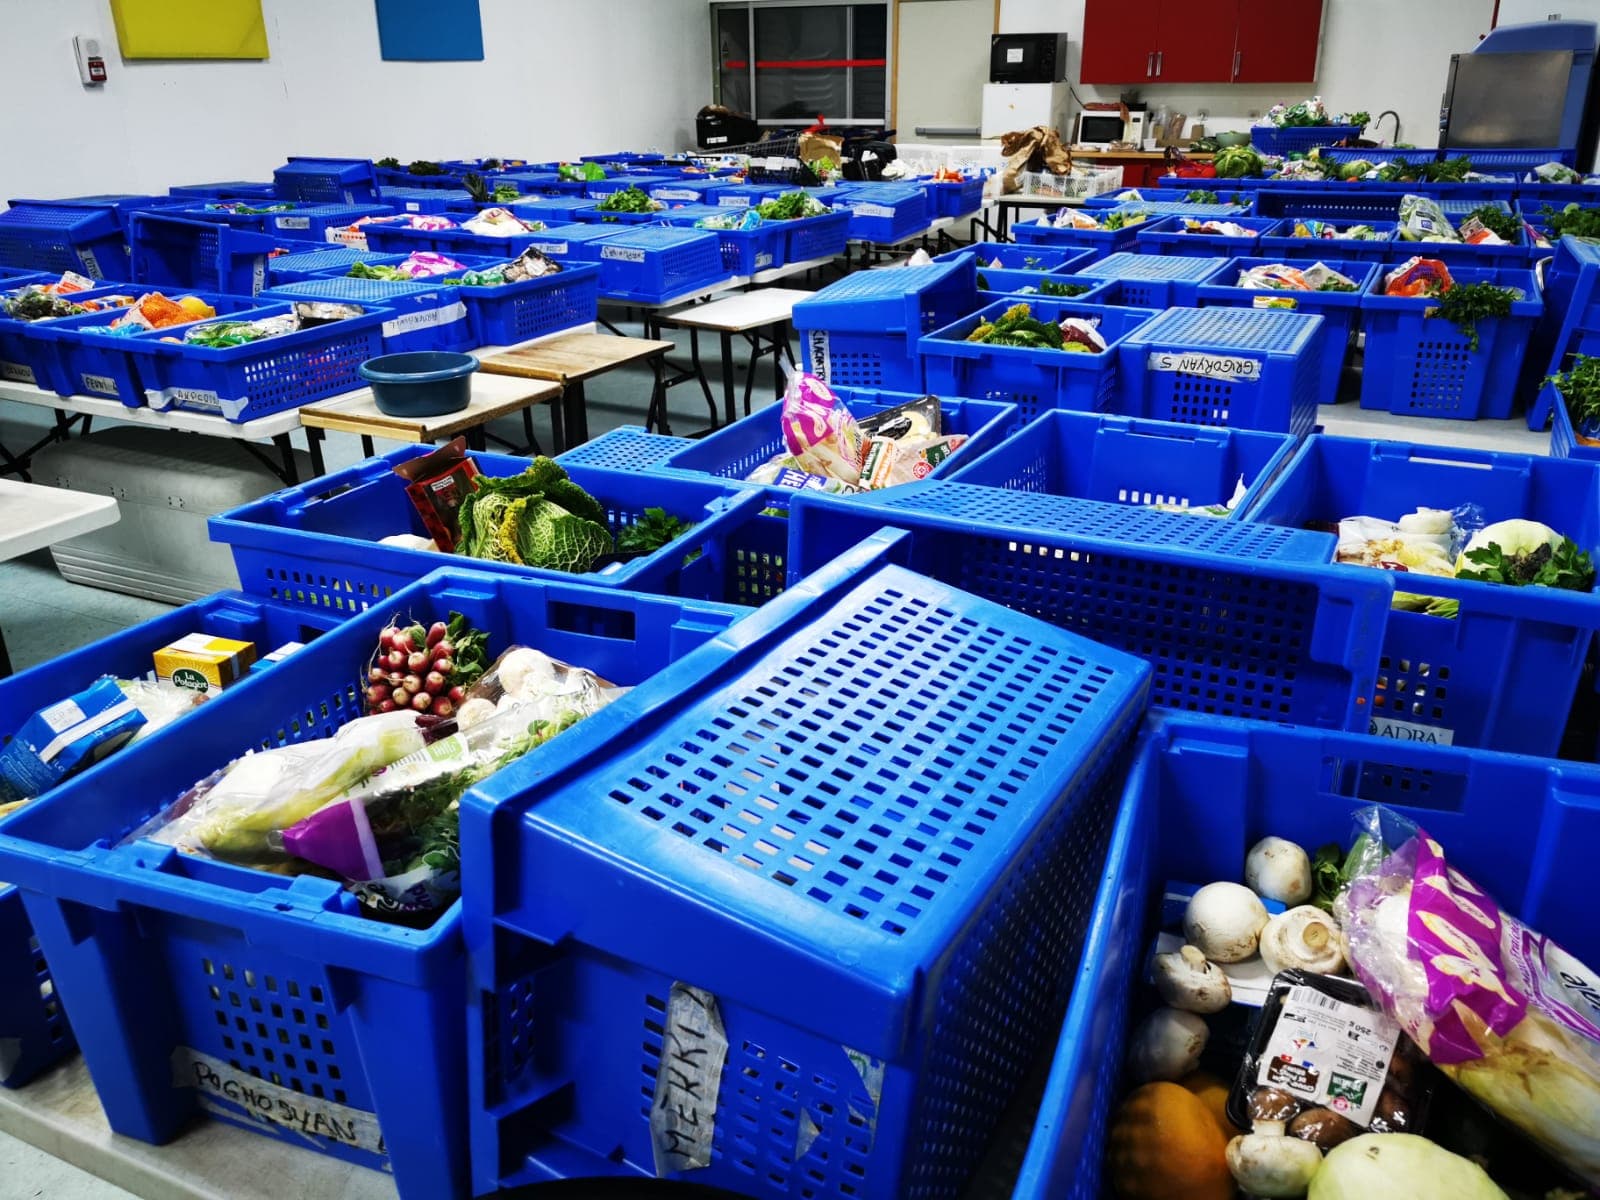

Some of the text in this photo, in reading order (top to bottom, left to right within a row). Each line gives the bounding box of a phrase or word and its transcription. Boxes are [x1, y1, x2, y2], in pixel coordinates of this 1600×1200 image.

[1177, 356, 1254, 376] GRIGORYAN
[184, 671, 195, 681] La
[1381, 724, 1438, 745] ADRA
[1354, 1024, 1373, 1036] 250
